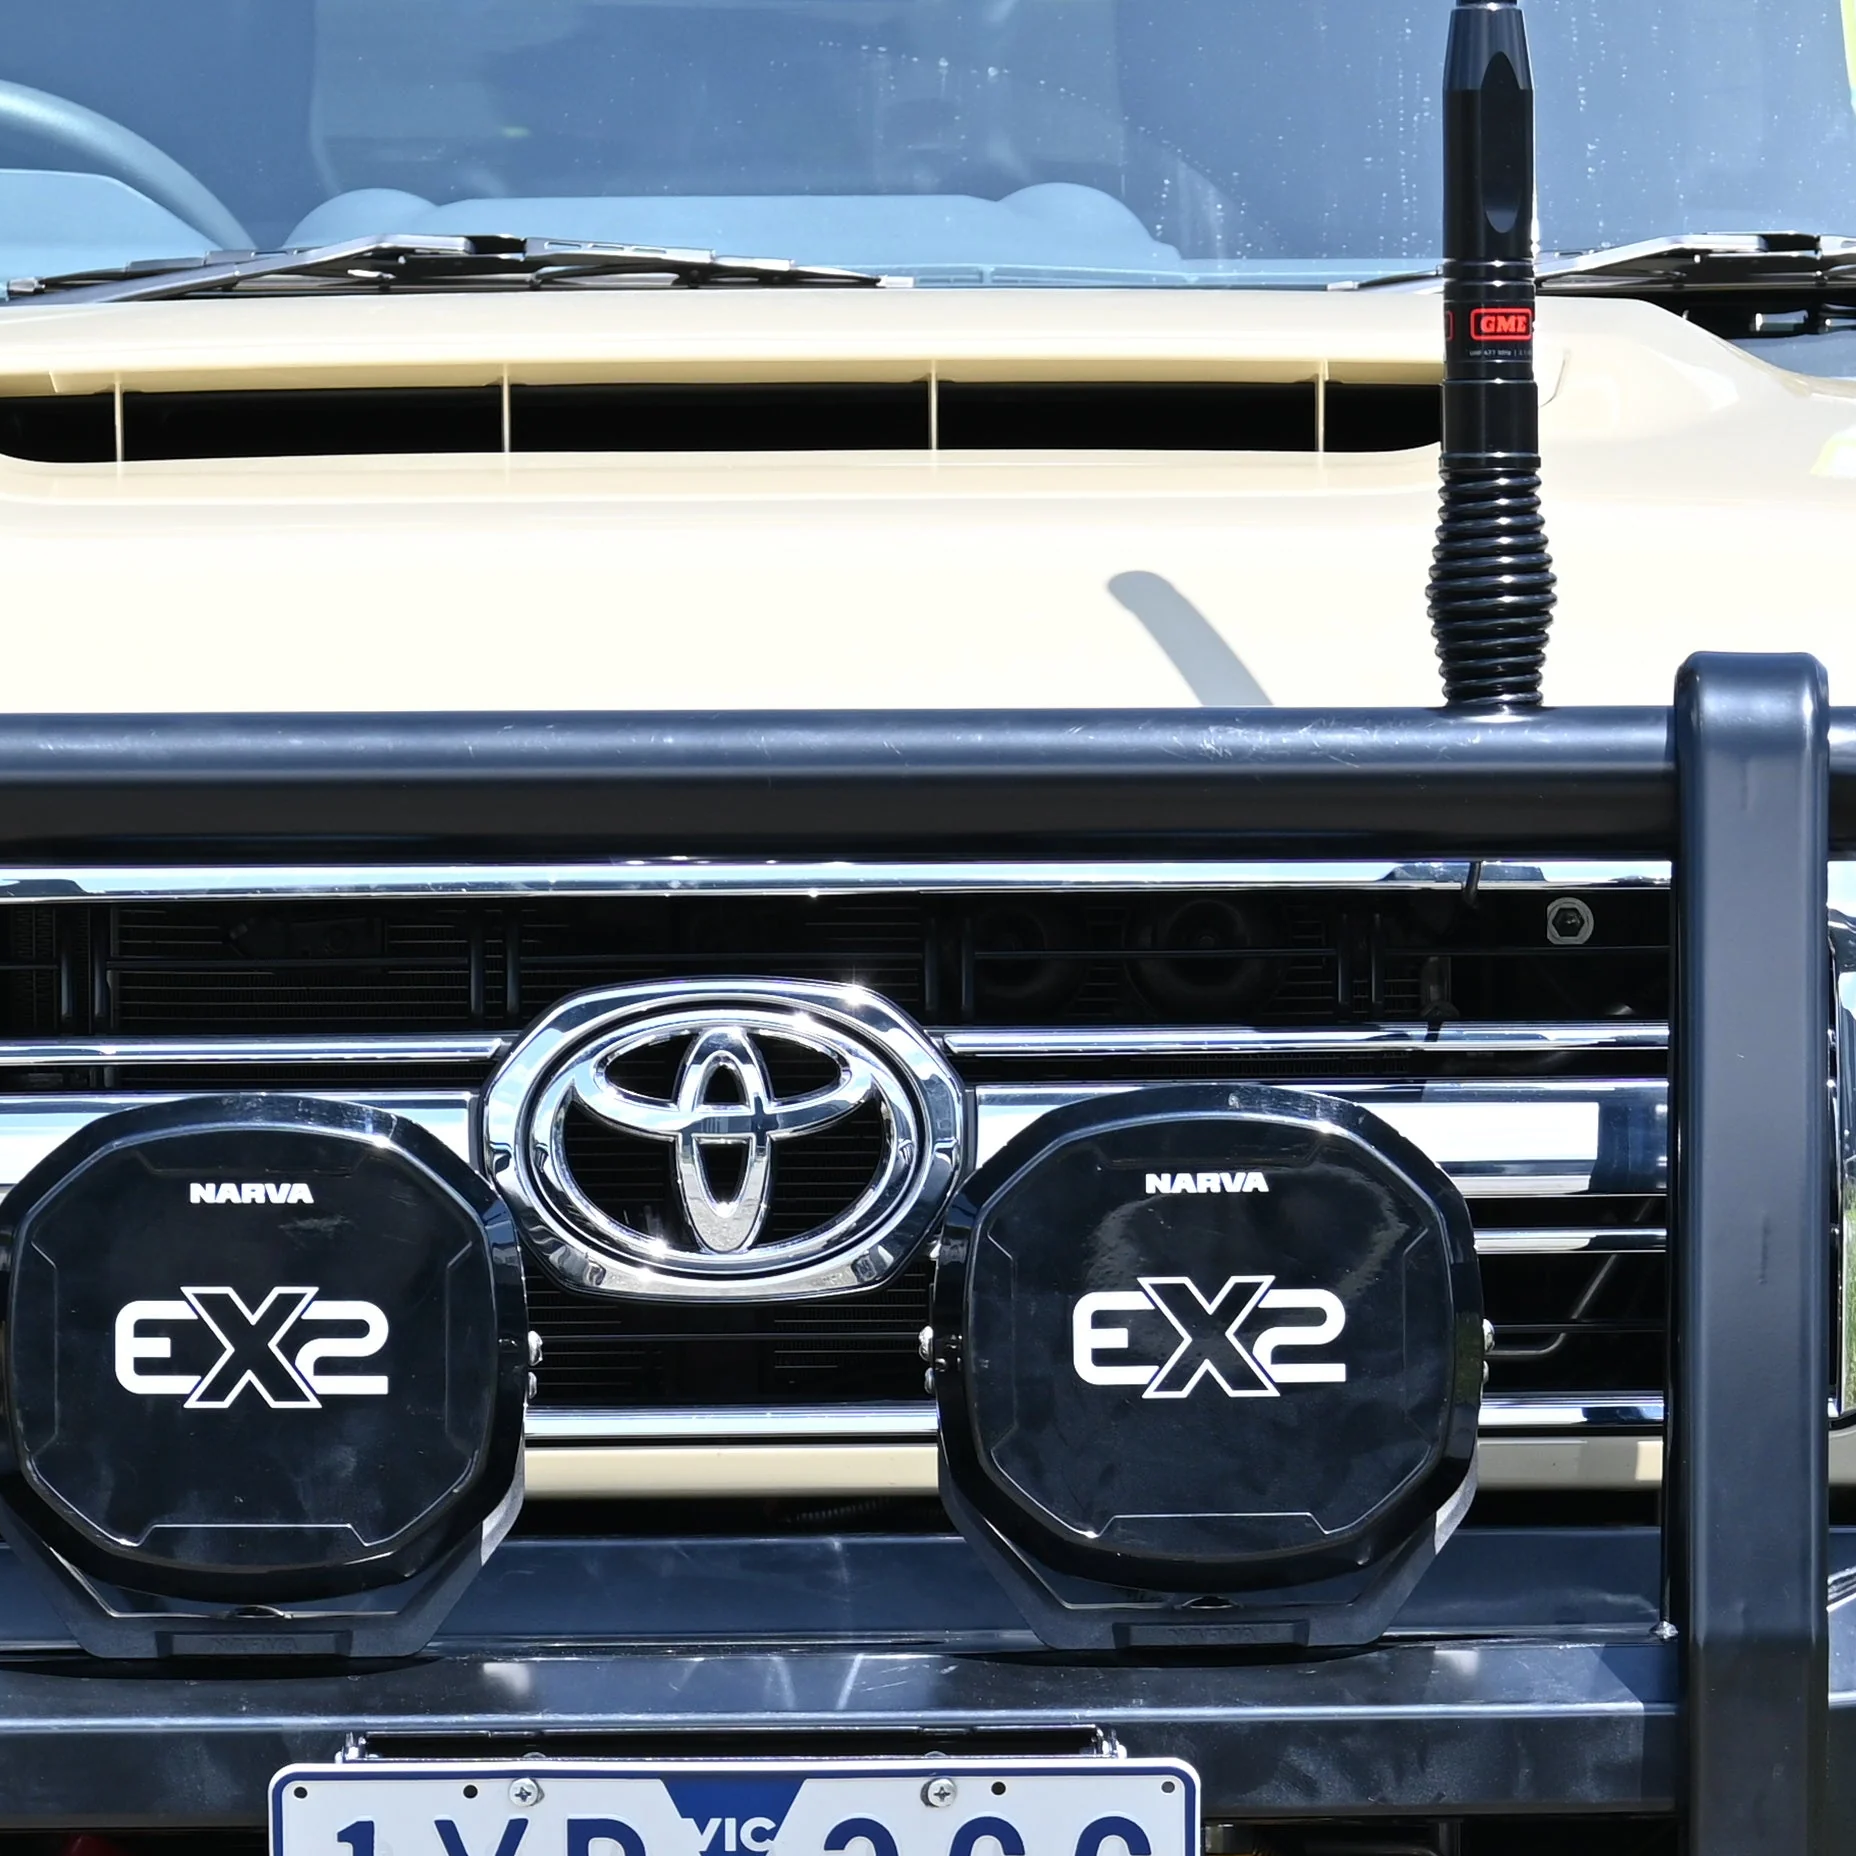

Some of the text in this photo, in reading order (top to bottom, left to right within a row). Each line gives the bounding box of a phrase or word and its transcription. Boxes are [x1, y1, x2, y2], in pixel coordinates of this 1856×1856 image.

[1480, 315, 1528, 333] GME
[189, 1182, 315, 1204] NARVA
[1144, 1171, 1269, 1194] NARVA
[114, 1285, 390, 1409] EX2
[1072, 1274, 1347, 1399] EX2
[681, 1816, 777, 1852] VIC
